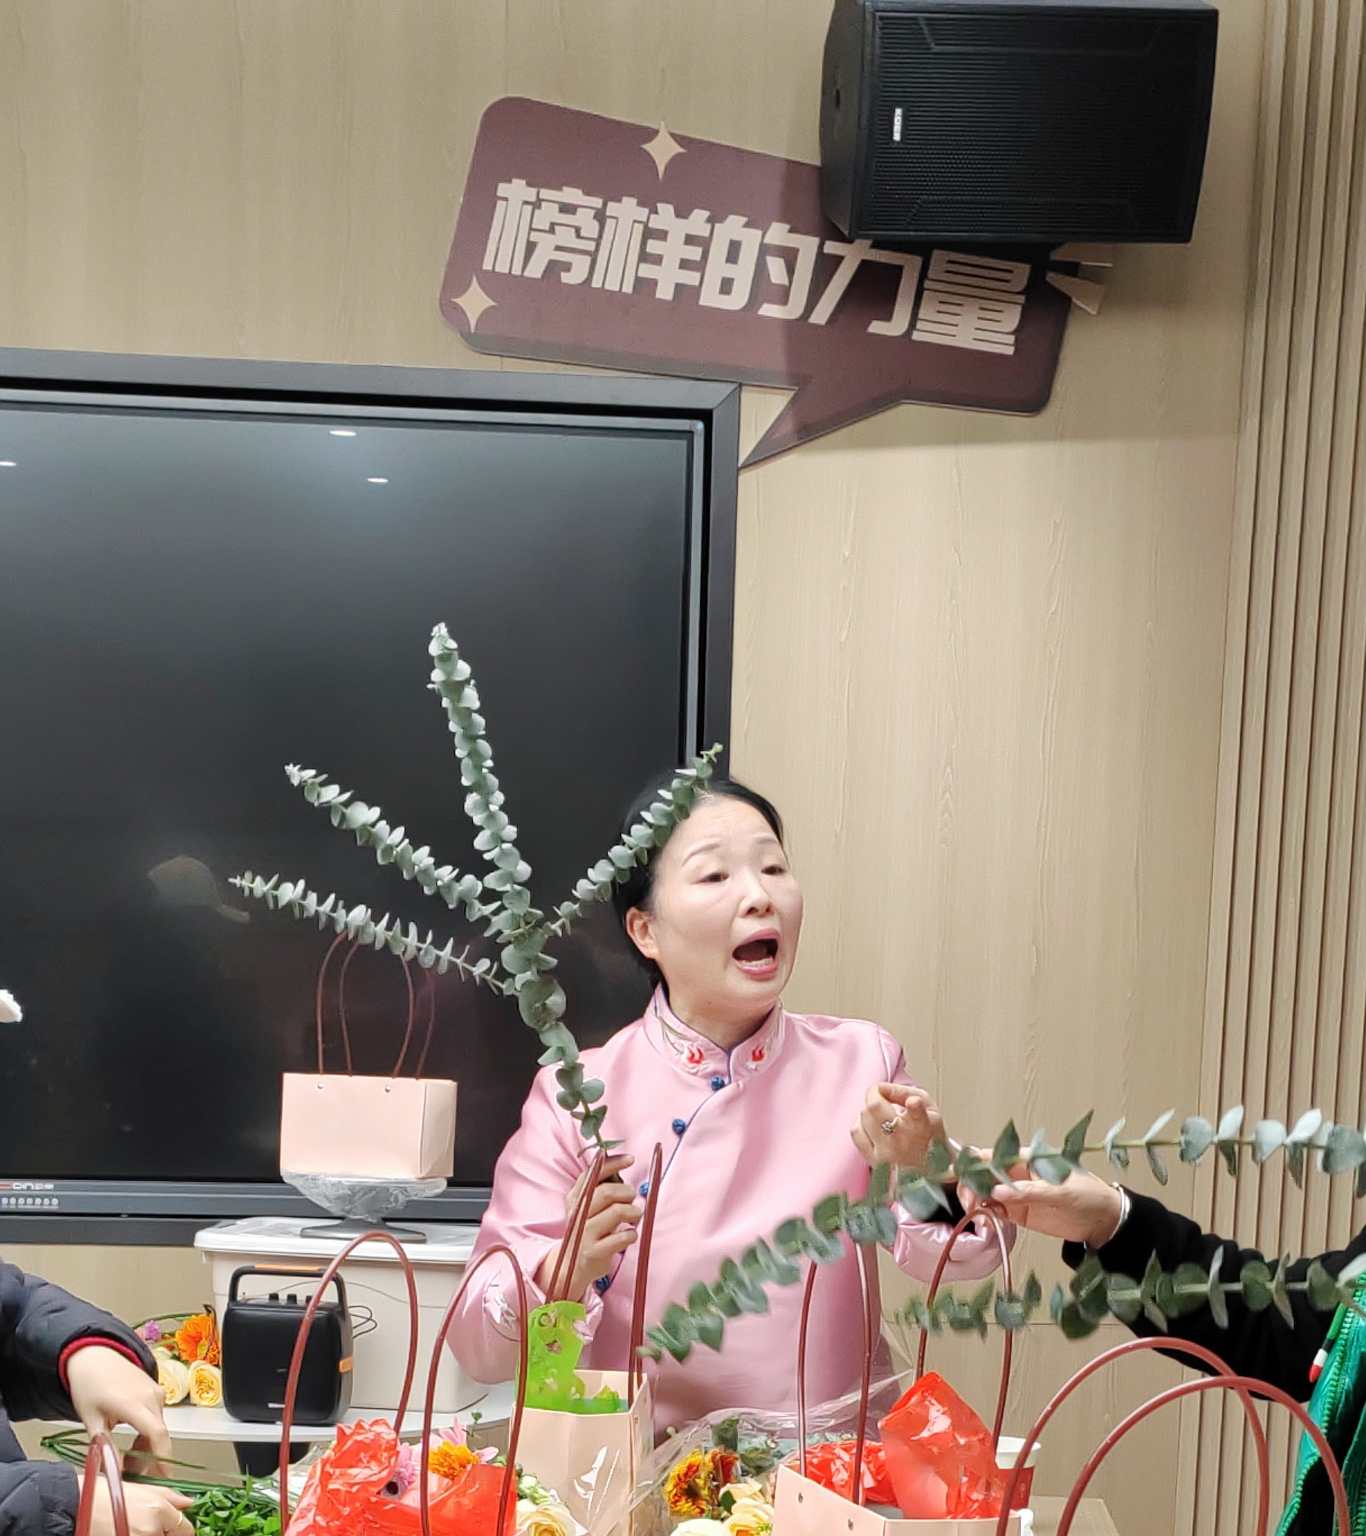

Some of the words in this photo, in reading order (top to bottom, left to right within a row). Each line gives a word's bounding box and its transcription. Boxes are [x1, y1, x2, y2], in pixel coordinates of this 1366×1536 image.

[481, 177, 1032, 357] 榜样的力量
